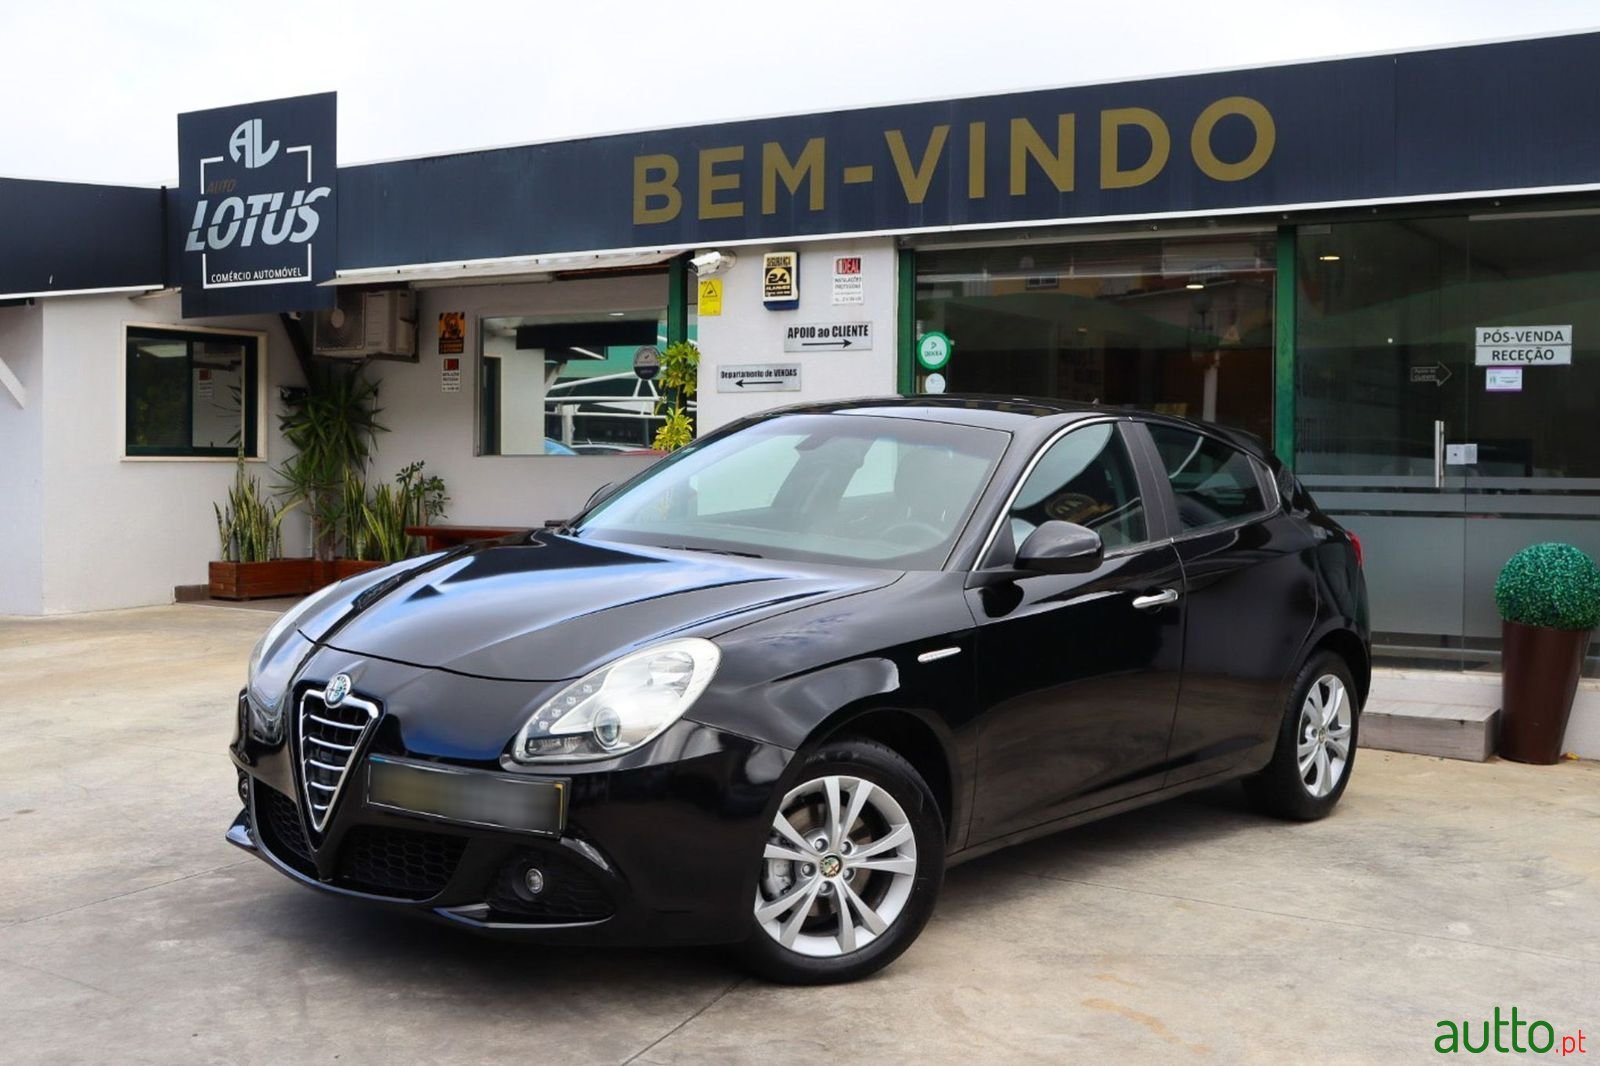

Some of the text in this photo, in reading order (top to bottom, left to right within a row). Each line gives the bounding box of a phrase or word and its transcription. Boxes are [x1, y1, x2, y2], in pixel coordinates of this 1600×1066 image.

[229, 118, 280, 168] AL
[632, 96, 1276, 225] BEM-VINDO
[207, 179, 237, 193] AUTO
[185, 186, 331, 252] LOTUS
[211, 266, 302, 283] COMÉRCIO AUTOMÓVEL
[767, 273, 787, 284] 24
[787, 324, 869, 339] APOIO ao CLIENTE
[1483, 329, 1564, 343] PÓS-VENDA
[1492, 346, 1555, 363] RECEÇÃO
[720, 368, 797, 380] Departamento de VENDAS
